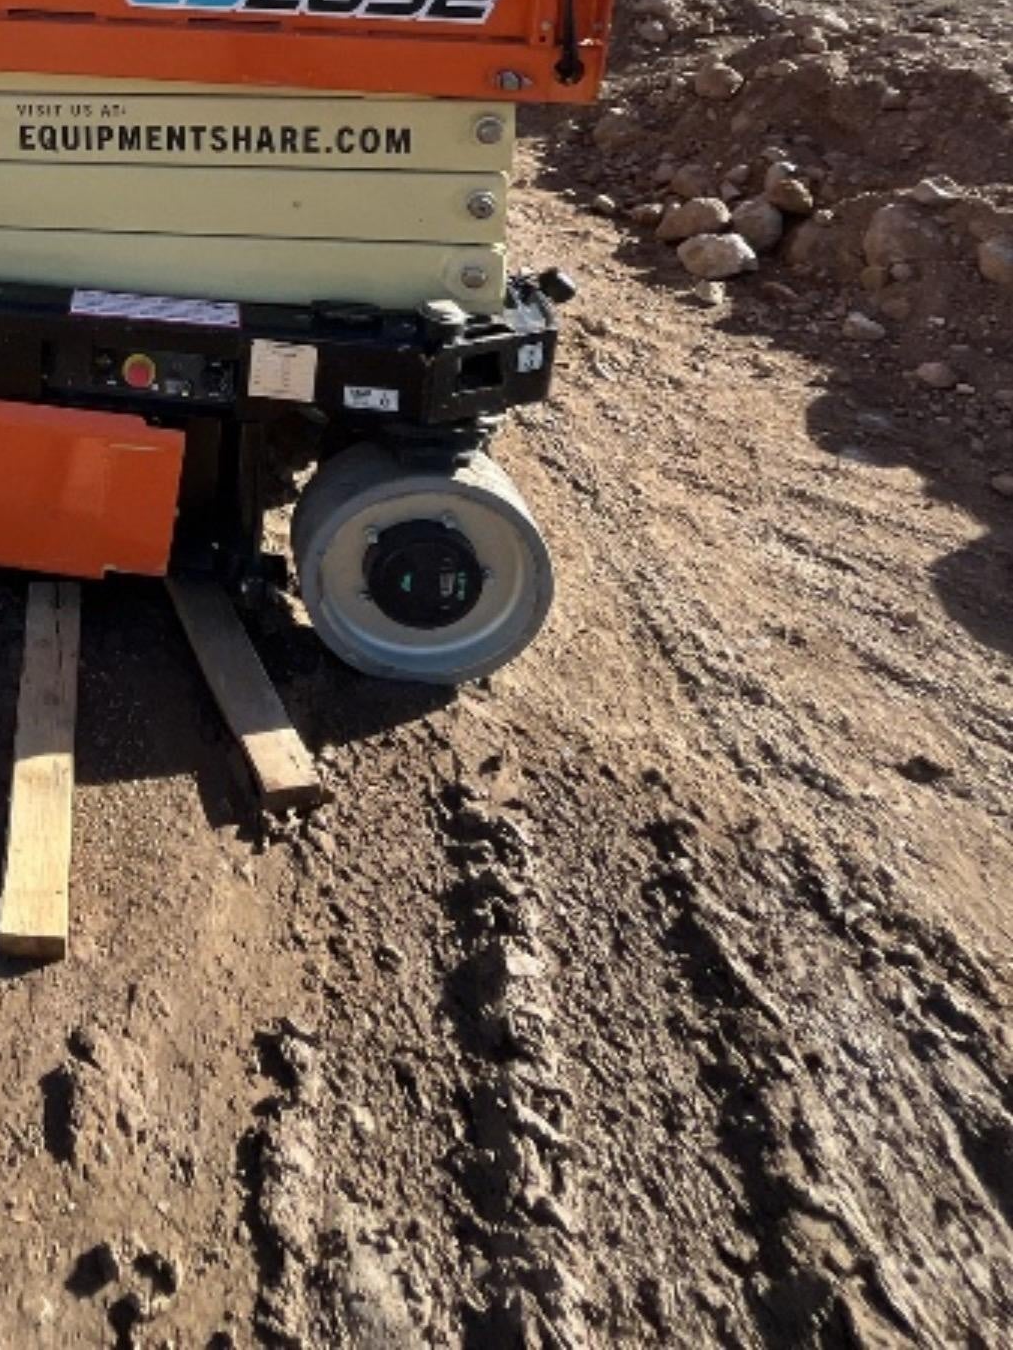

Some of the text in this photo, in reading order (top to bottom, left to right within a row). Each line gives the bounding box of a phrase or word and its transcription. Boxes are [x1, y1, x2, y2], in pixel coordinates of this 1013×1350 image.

[17, 104, 62, 117] VISIT
[70, 104, 92, 117] US
[18, 124, 412, 154] EQUIPMENTSHARE.COM
